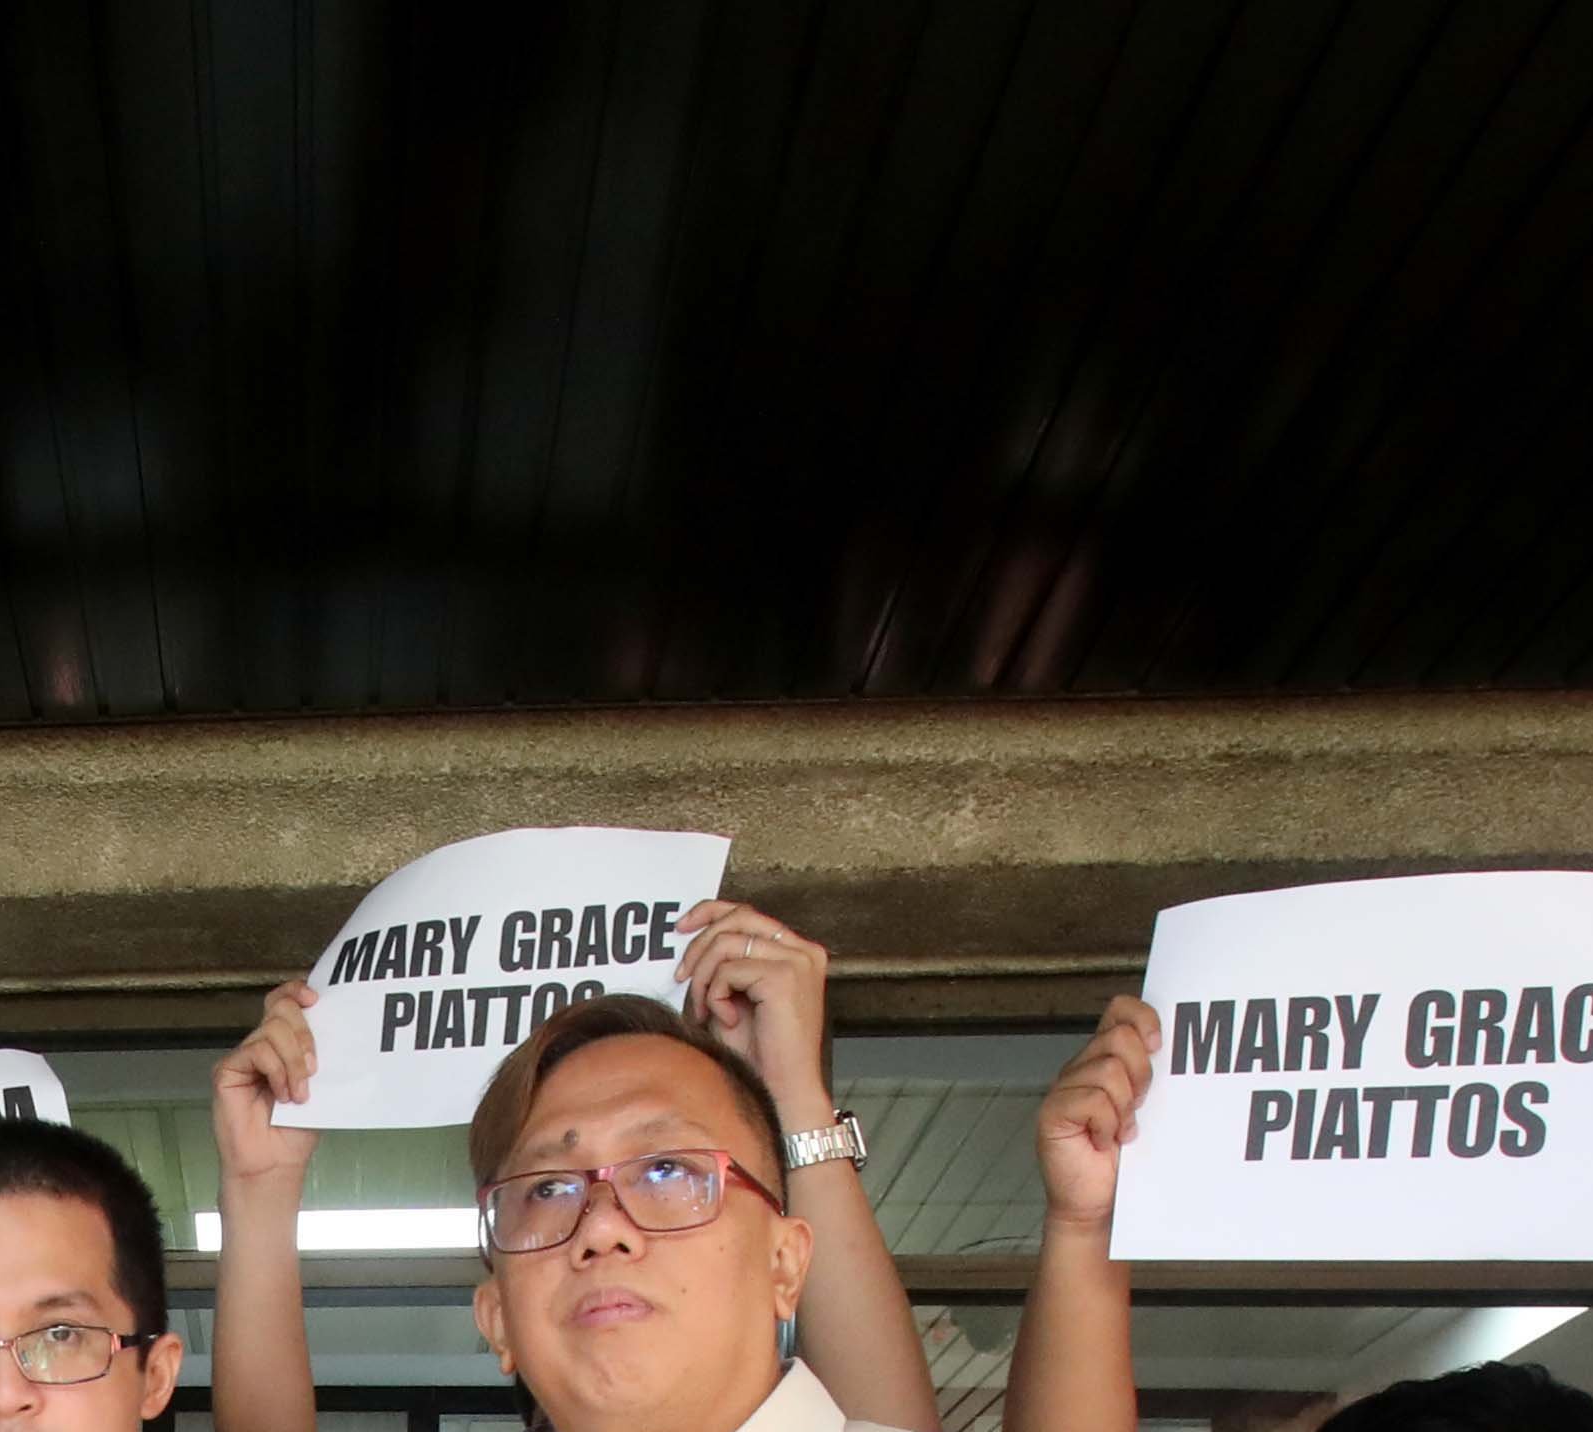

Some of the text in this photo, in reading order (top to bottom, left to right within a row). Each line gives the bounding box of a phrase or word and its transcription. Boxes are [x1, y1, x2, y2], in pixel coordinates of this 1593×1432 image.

[328, 901, 681, 987] MARY GRACE
[380, 980, 605, 1052] PIATTO
[1171, 993, 1381, 1075] MARY
[1244, 1081, 1550, 1161] PIATTOS
